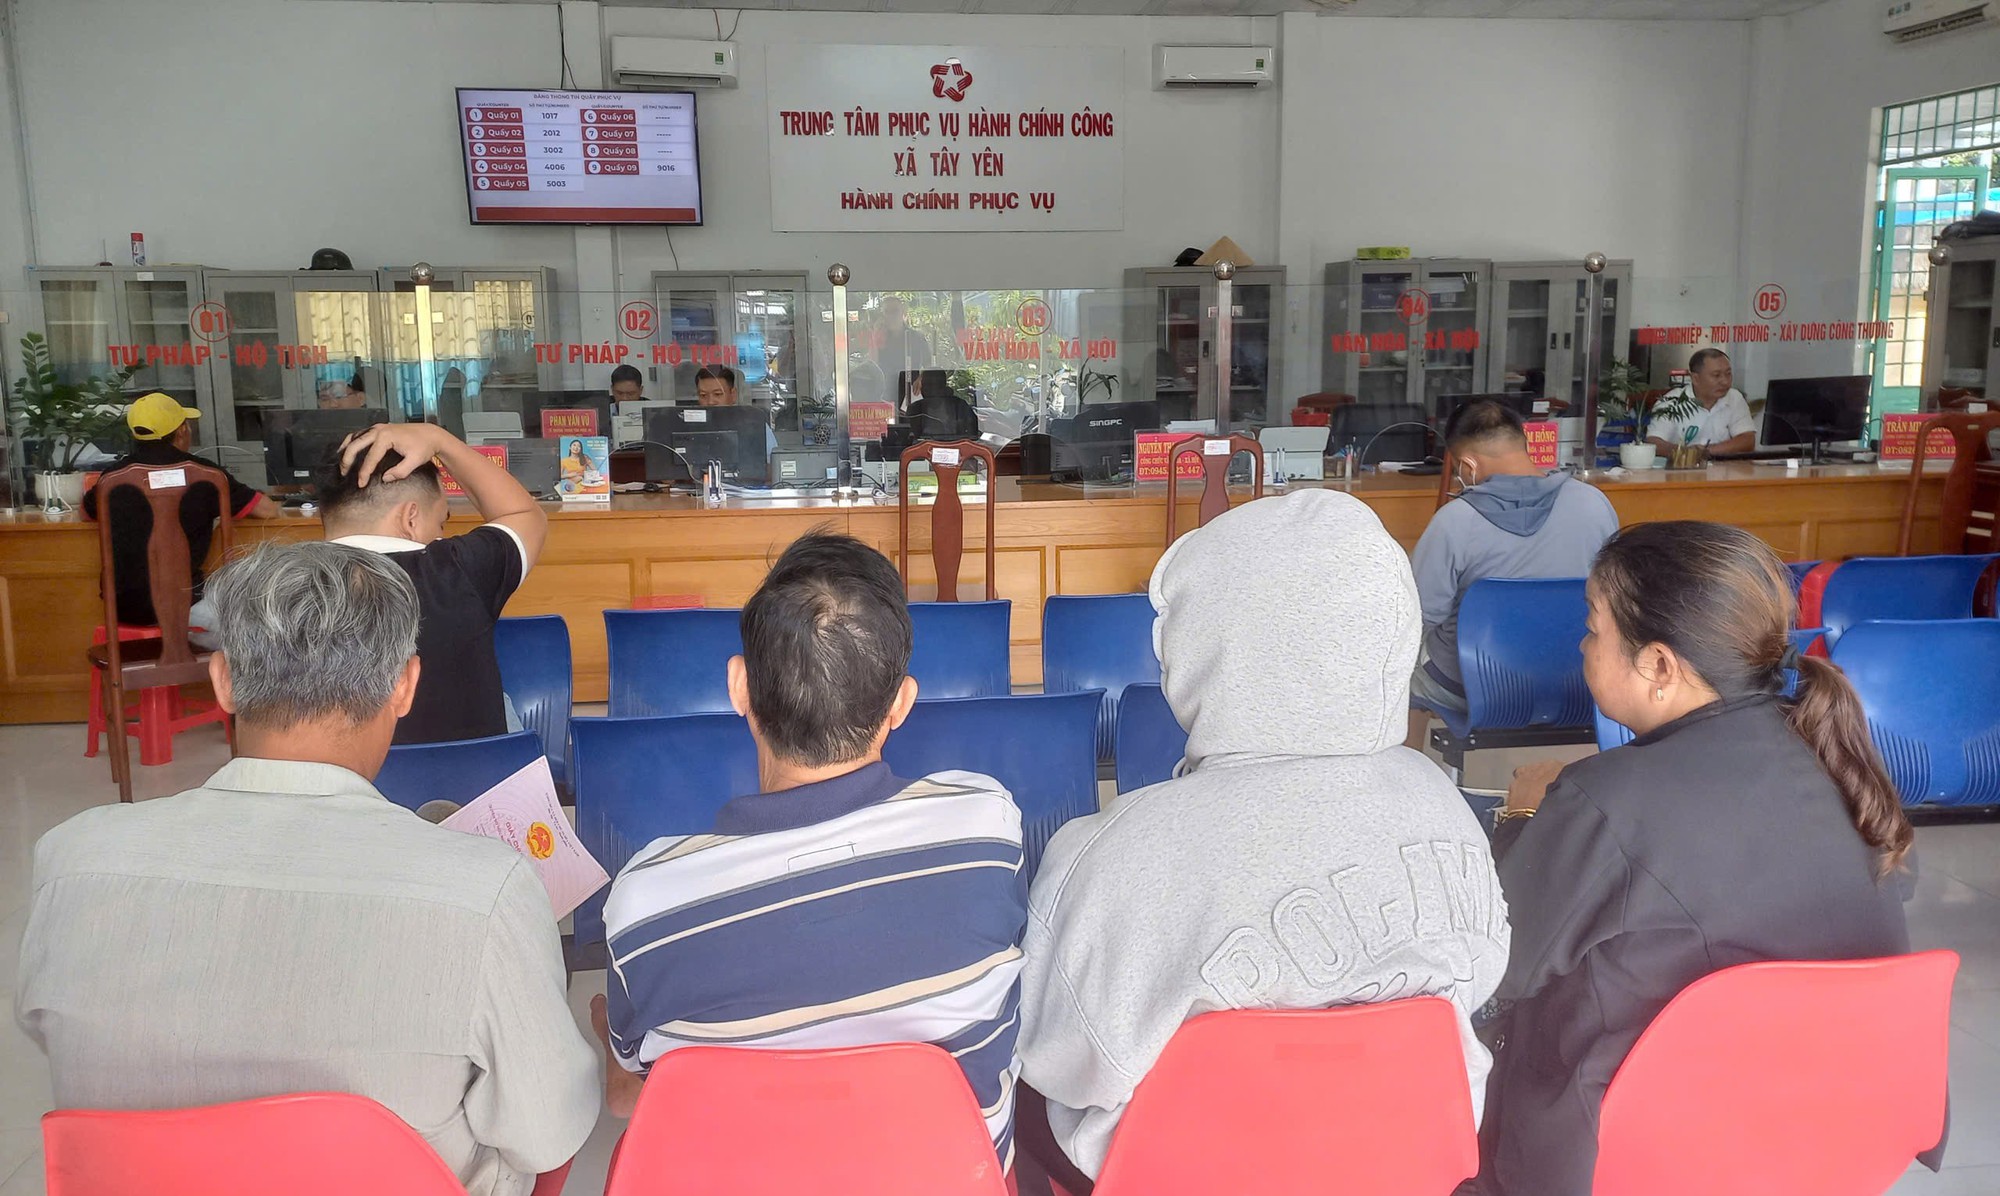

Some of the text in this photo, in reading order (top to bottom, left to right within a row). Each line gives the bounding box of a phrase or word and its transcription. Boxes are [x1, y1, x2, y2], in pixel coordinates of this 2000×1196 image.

[542, 112, 558, 120] 1017
[780, 106, 1114, 141] TRUNG TÂM PHỤC VỤ HÀNH CHÍNH CÔNG
[544, 146, 564, 154] 3002
[894, 146, 1004, 177] XÃ TÂY YÊN
[657, 164, 675, 172] 9016
[546, 180, 566, 188] 5003
[841, 187, 1055, 214] HÀNH CHÍNH PHỤC VỤ
[1401, 296, 1425, 317] 04
[1758, 292, 1780, 312] 05
[200, 310, 225, 334] 01
[625, 309, 651, 331] 02
[1022, 307, 1046, 327] 03
[1424, 327, 1446, 350] XÃ
[1451, 326, 1480, 352] HỘI
[1711, 322, 1730, 344] MÔI
[1733, 321, 1769, 343] TRƯỜNG
[1780, 322, 1799, 341] XÂY
[1800, 323, 1825, 345] DỰNG
[1828, 320, 1854, 340] CÔNG
[108, 344, 139, 367] TƯ
[146, 340, 210, 367] PHÁP
[533, 342, 563, 364] TƯ
[568, 340, 629, 364] PHÁP
[652, 340, 682, 367] HỘ
[690, 344, 738, 368] TỊCH
[1058, 337, 1082, 360] XÃ
[1087, 336, 1118, 362] HỘI
